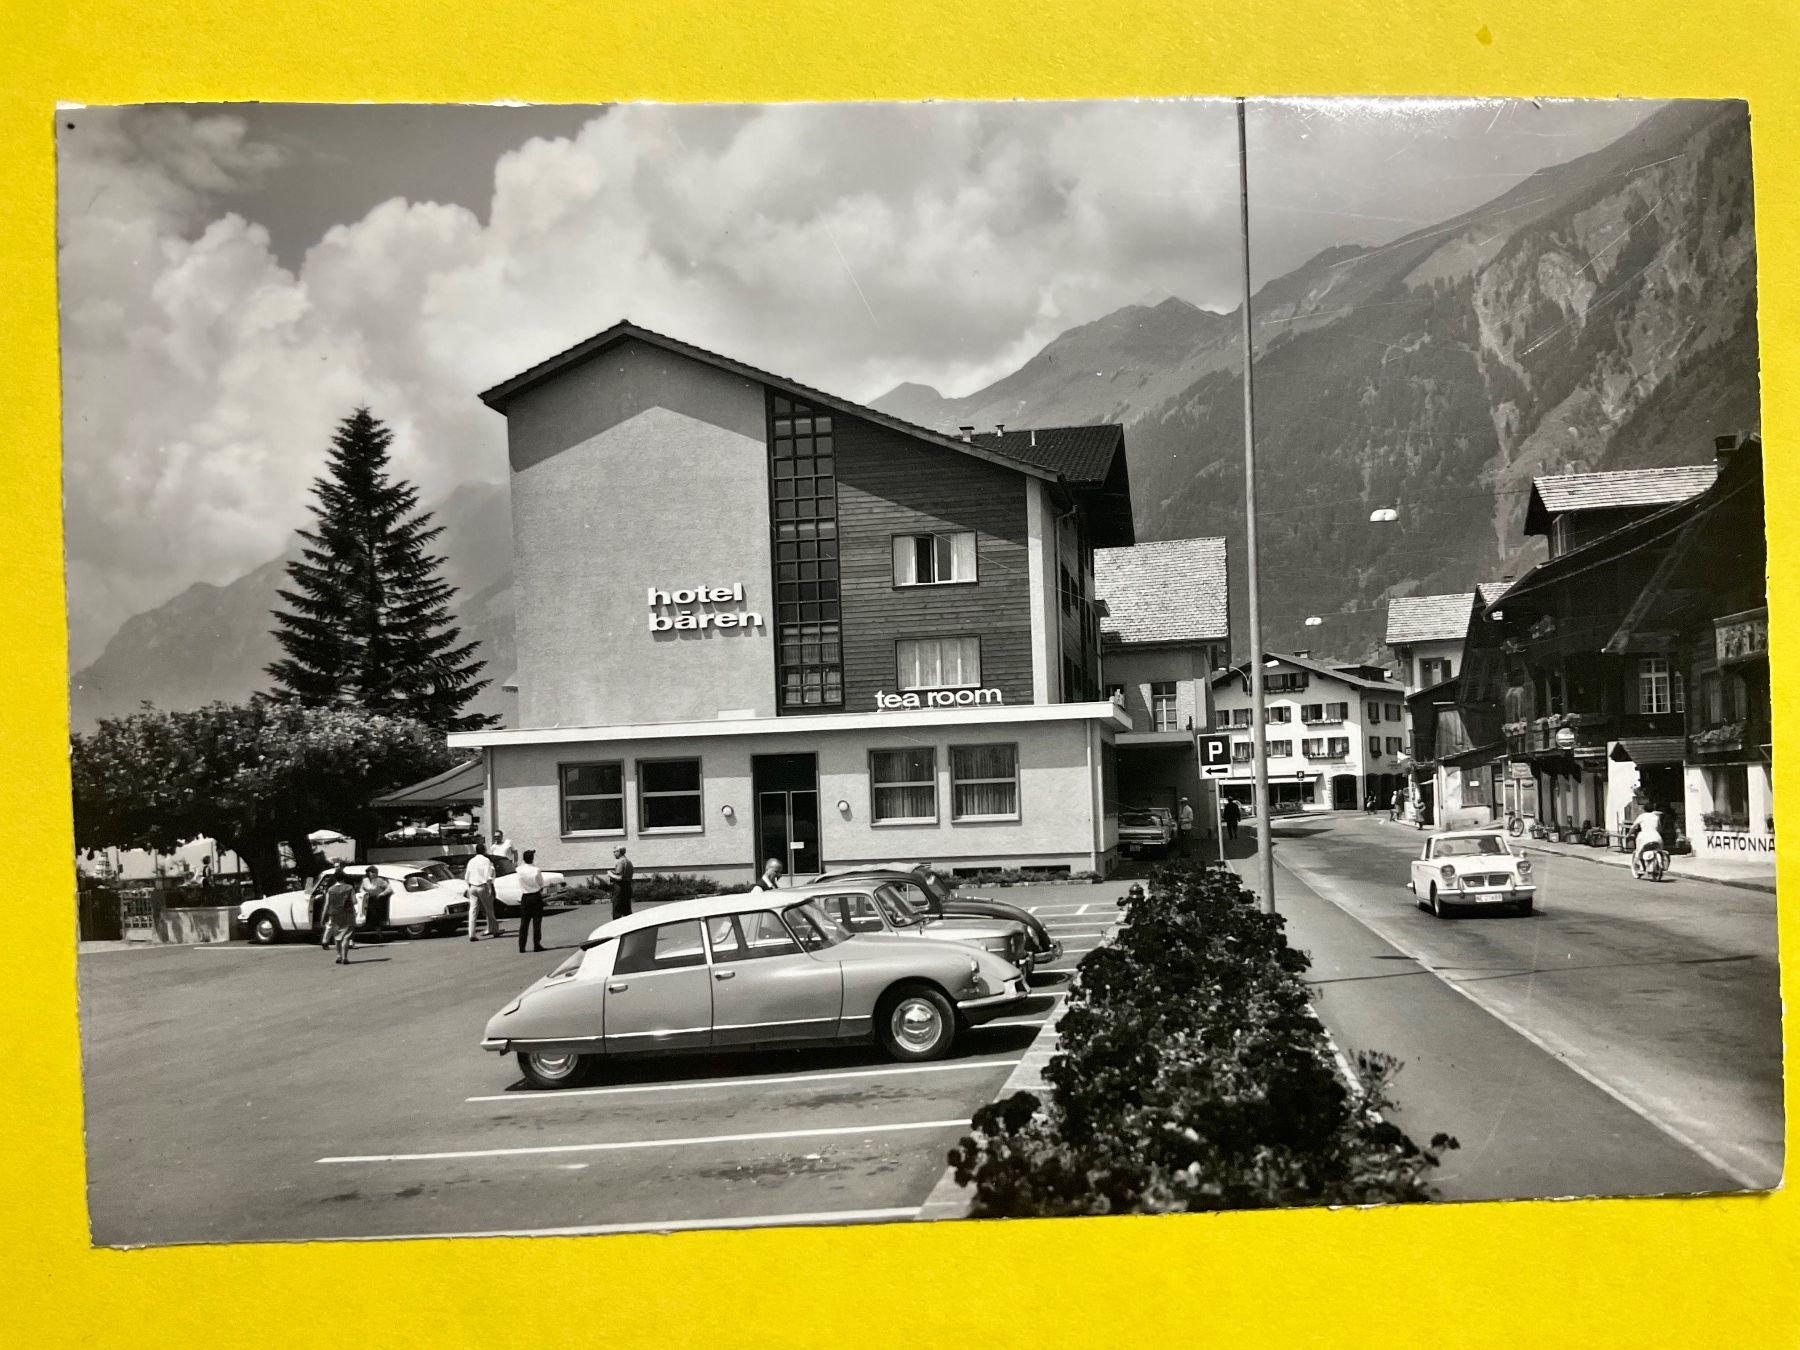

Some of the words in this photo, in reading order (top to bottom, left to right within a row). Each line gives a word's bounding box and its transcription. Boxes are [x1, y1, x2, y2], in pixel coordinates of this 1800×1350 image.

[648, 583, 742, 606] hotel
[874, 690, 920, 708] tea
[927, 688, 1003, 706] room
[1208, 741, 1223, 762] P
[1707, 835, 1775, 852] KARTONNA
